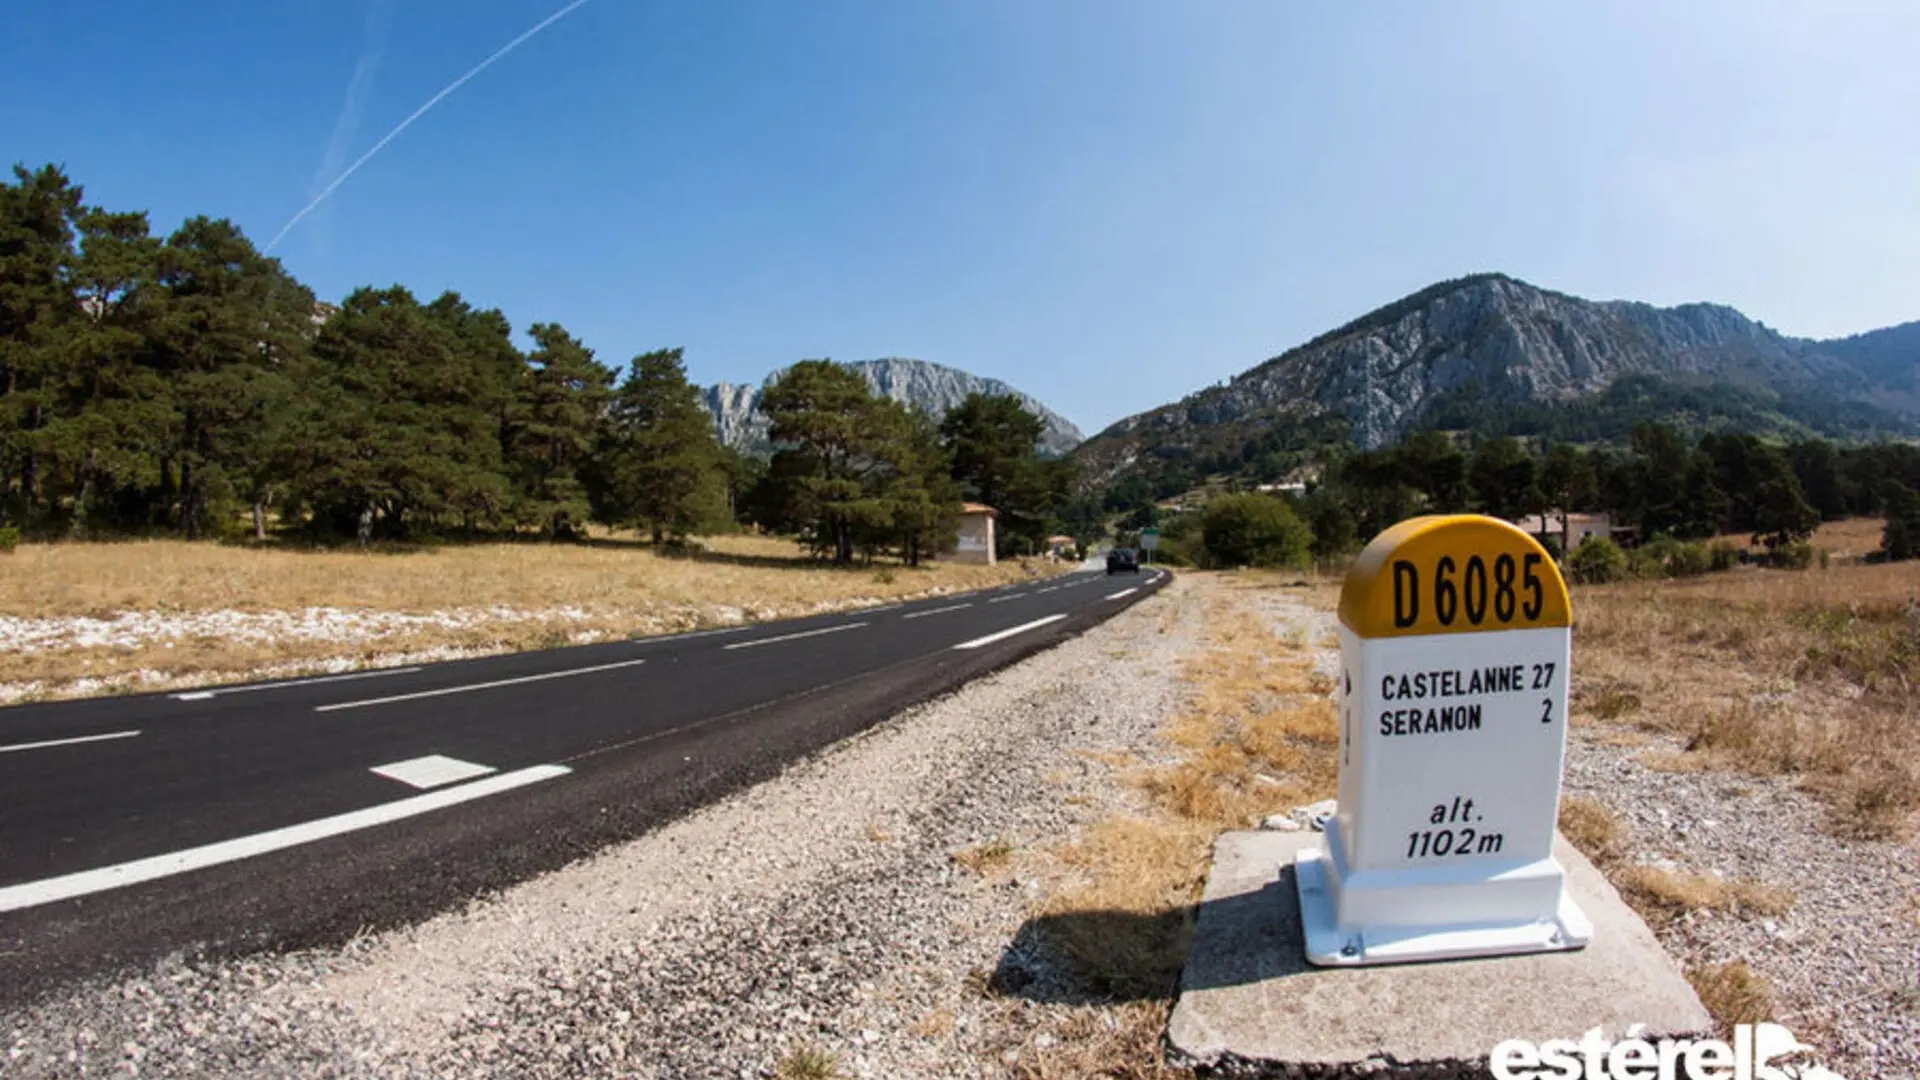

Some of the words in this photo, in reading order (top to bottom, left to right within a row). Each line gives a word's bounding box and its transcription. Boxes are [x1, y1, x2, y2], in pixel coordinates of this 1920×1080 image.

[1393, 560, 1419, 628] D
[1434, 552, 1543, 627] 6085
[1381, 664, 1525, 701] CASTELANNE
[1531, 662, 1556, 690] 27
[1379, 703, 1482, 737] SERANON
[1541, 697, 1554, 724] 2
[1429, 796, 1484, 825] alt.
[1406, 827, 1504, 859] 1102m
